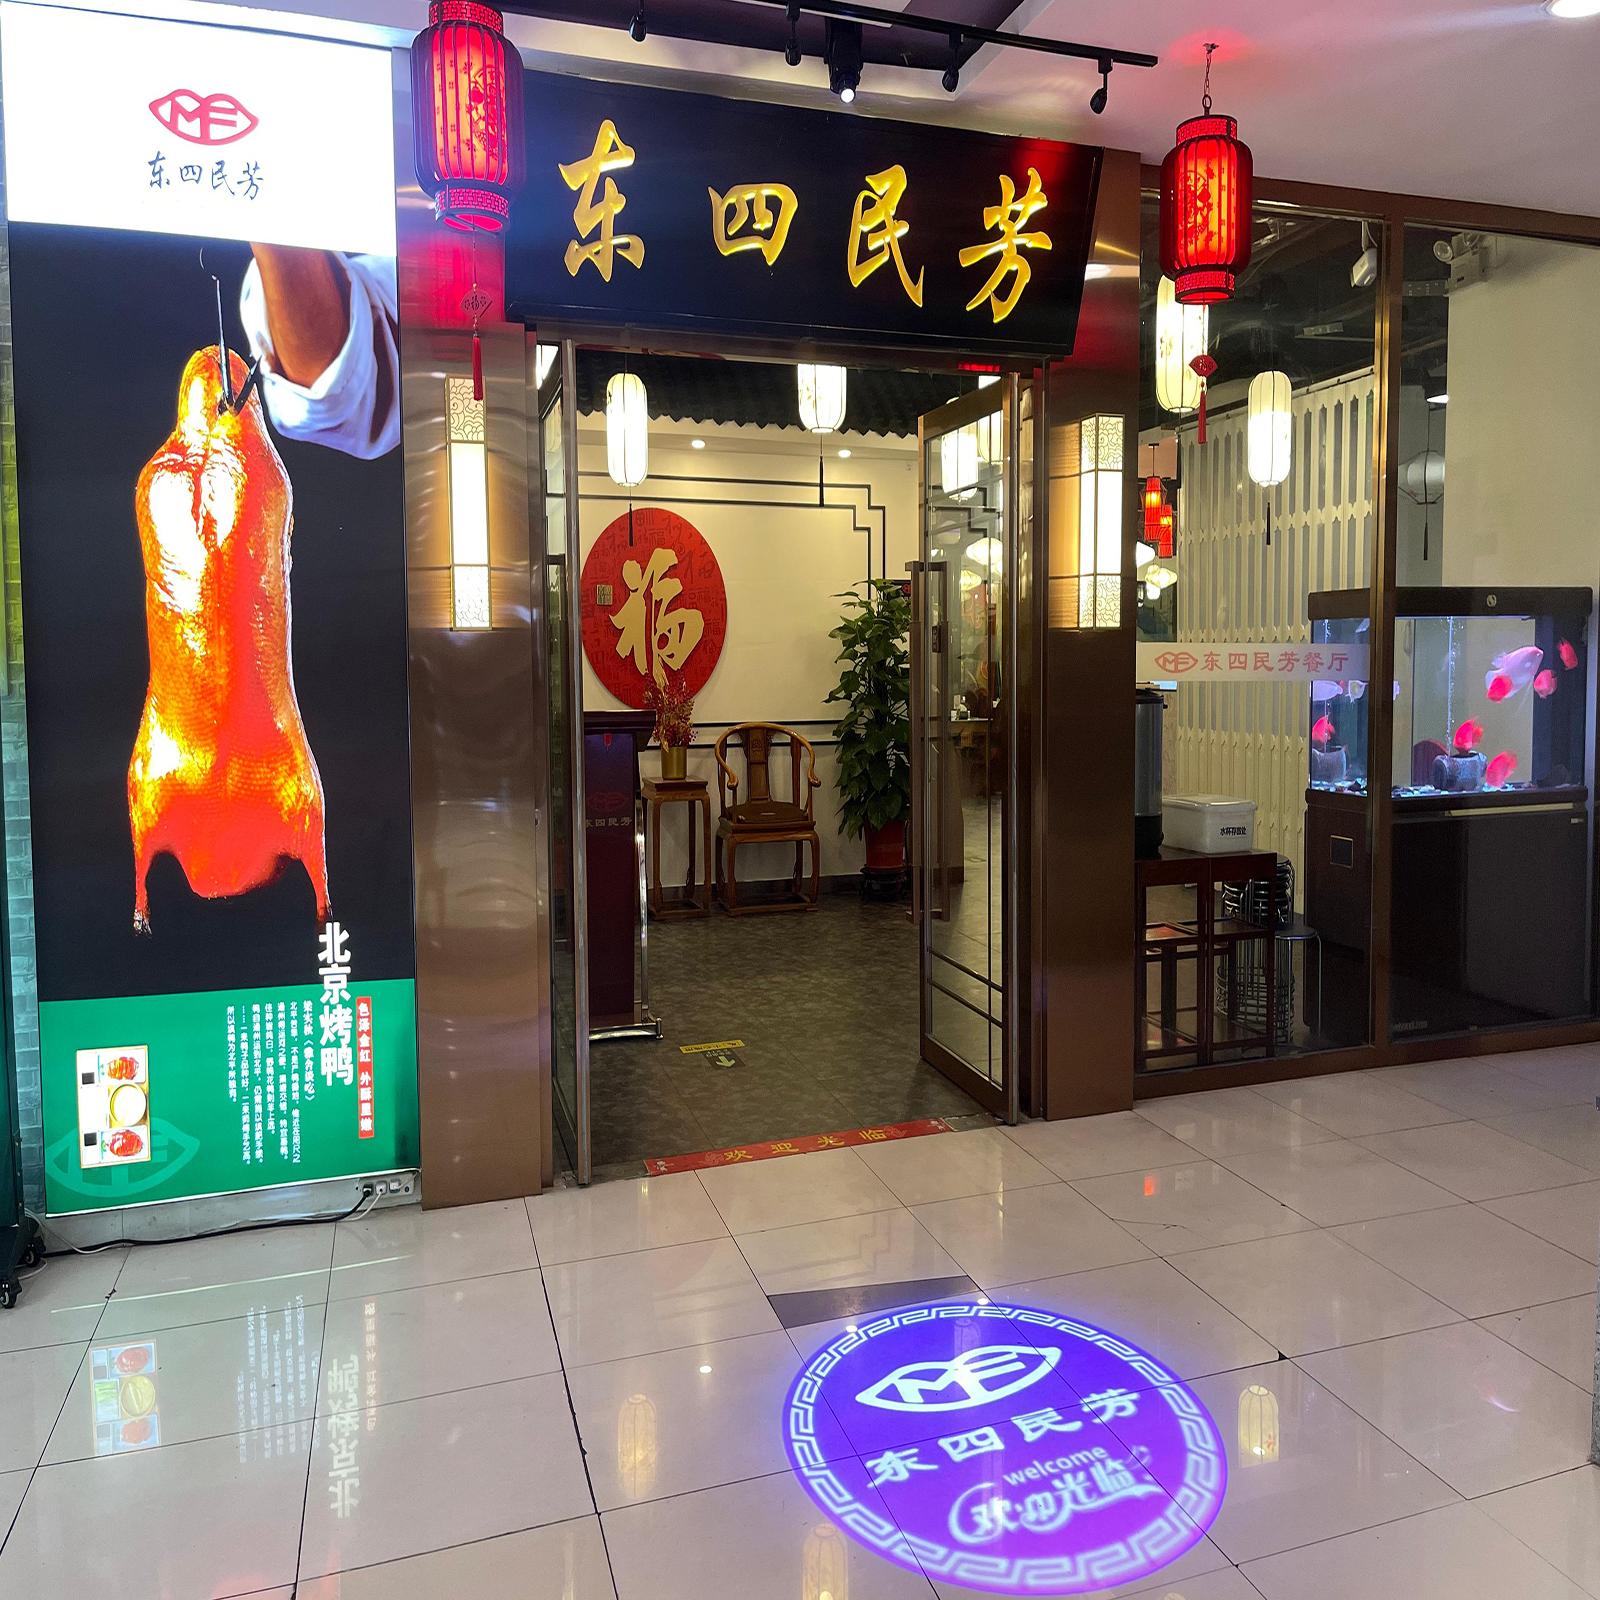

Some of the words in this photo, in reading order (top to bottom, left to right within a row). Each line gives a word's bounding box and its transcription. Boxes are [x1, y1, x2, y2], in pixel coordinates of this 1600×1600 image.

[147, 150, 265, 201] 东四民芳
[558, 119, 1053, 323] 东四民芳
[609, 548, 705, 691] 福
[1200, 651, 1349, 673] 东四民芳餐厅
[317, 921, 354, 1086] 北京烤鸭
[358, 1002, 371, 1062] 色泽金红
[359, 1071, 373, 1132] 外酥里嫩
[724, 1129, 887, 1161] 欢迎光临
[865, 1388, 1140, 1488] 东四民芳
[1003, 1447, 1109, 1486] welcome
